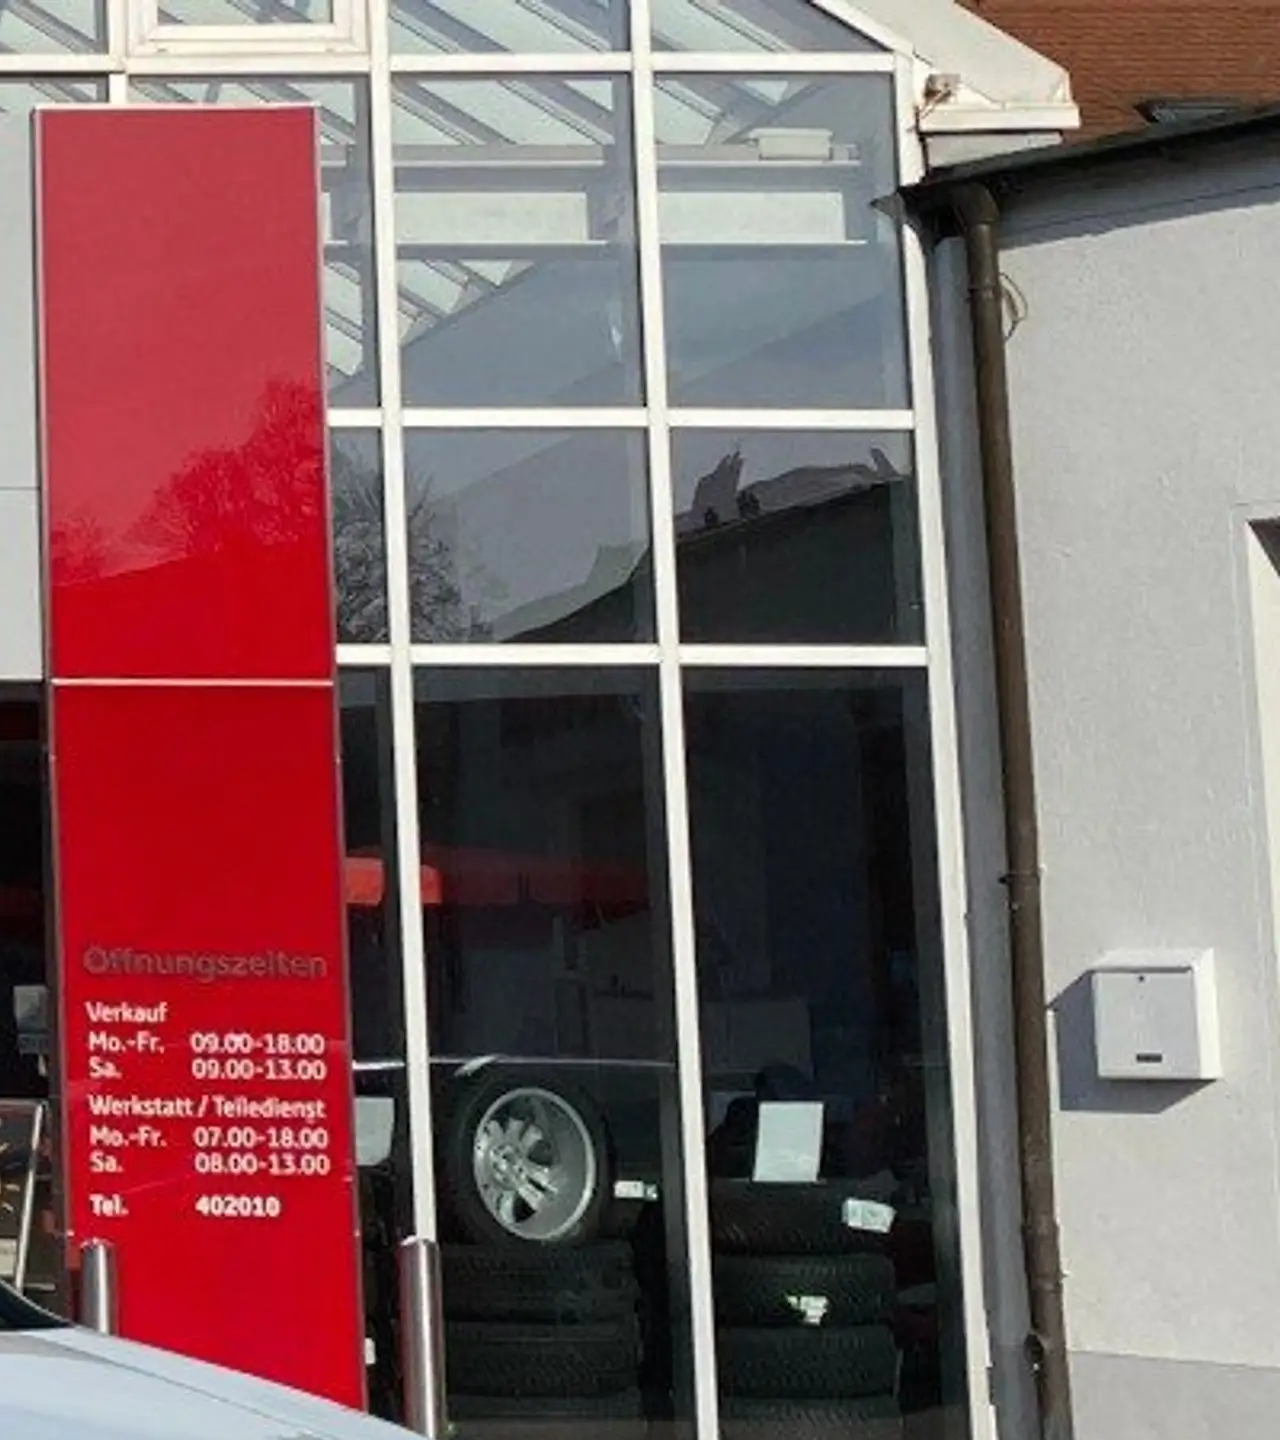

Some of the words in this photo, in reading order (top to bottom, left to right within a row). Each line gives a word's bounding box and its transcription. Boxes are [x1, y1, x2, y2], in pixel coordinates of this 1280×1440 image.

[83, 944, 328, 982] Öffnungszeiten
[86, 1002, 168, 1023] Verkauf
[88, 1031, 165, 1053] Mo.-Fr.
[88, 1058, 122, 1079] Sa.
[88, 1094, 193, 1117] Werkstatt
[212, 1097, 327, 1120] Teiledienst
[90, 1126, 167, 1148] Mo.-Fr.
[90, 1152, 124, 1174] Sa.
[89, 1194, 129, 1216] Tel.
[195, 1196, 281, 1218] 402010
